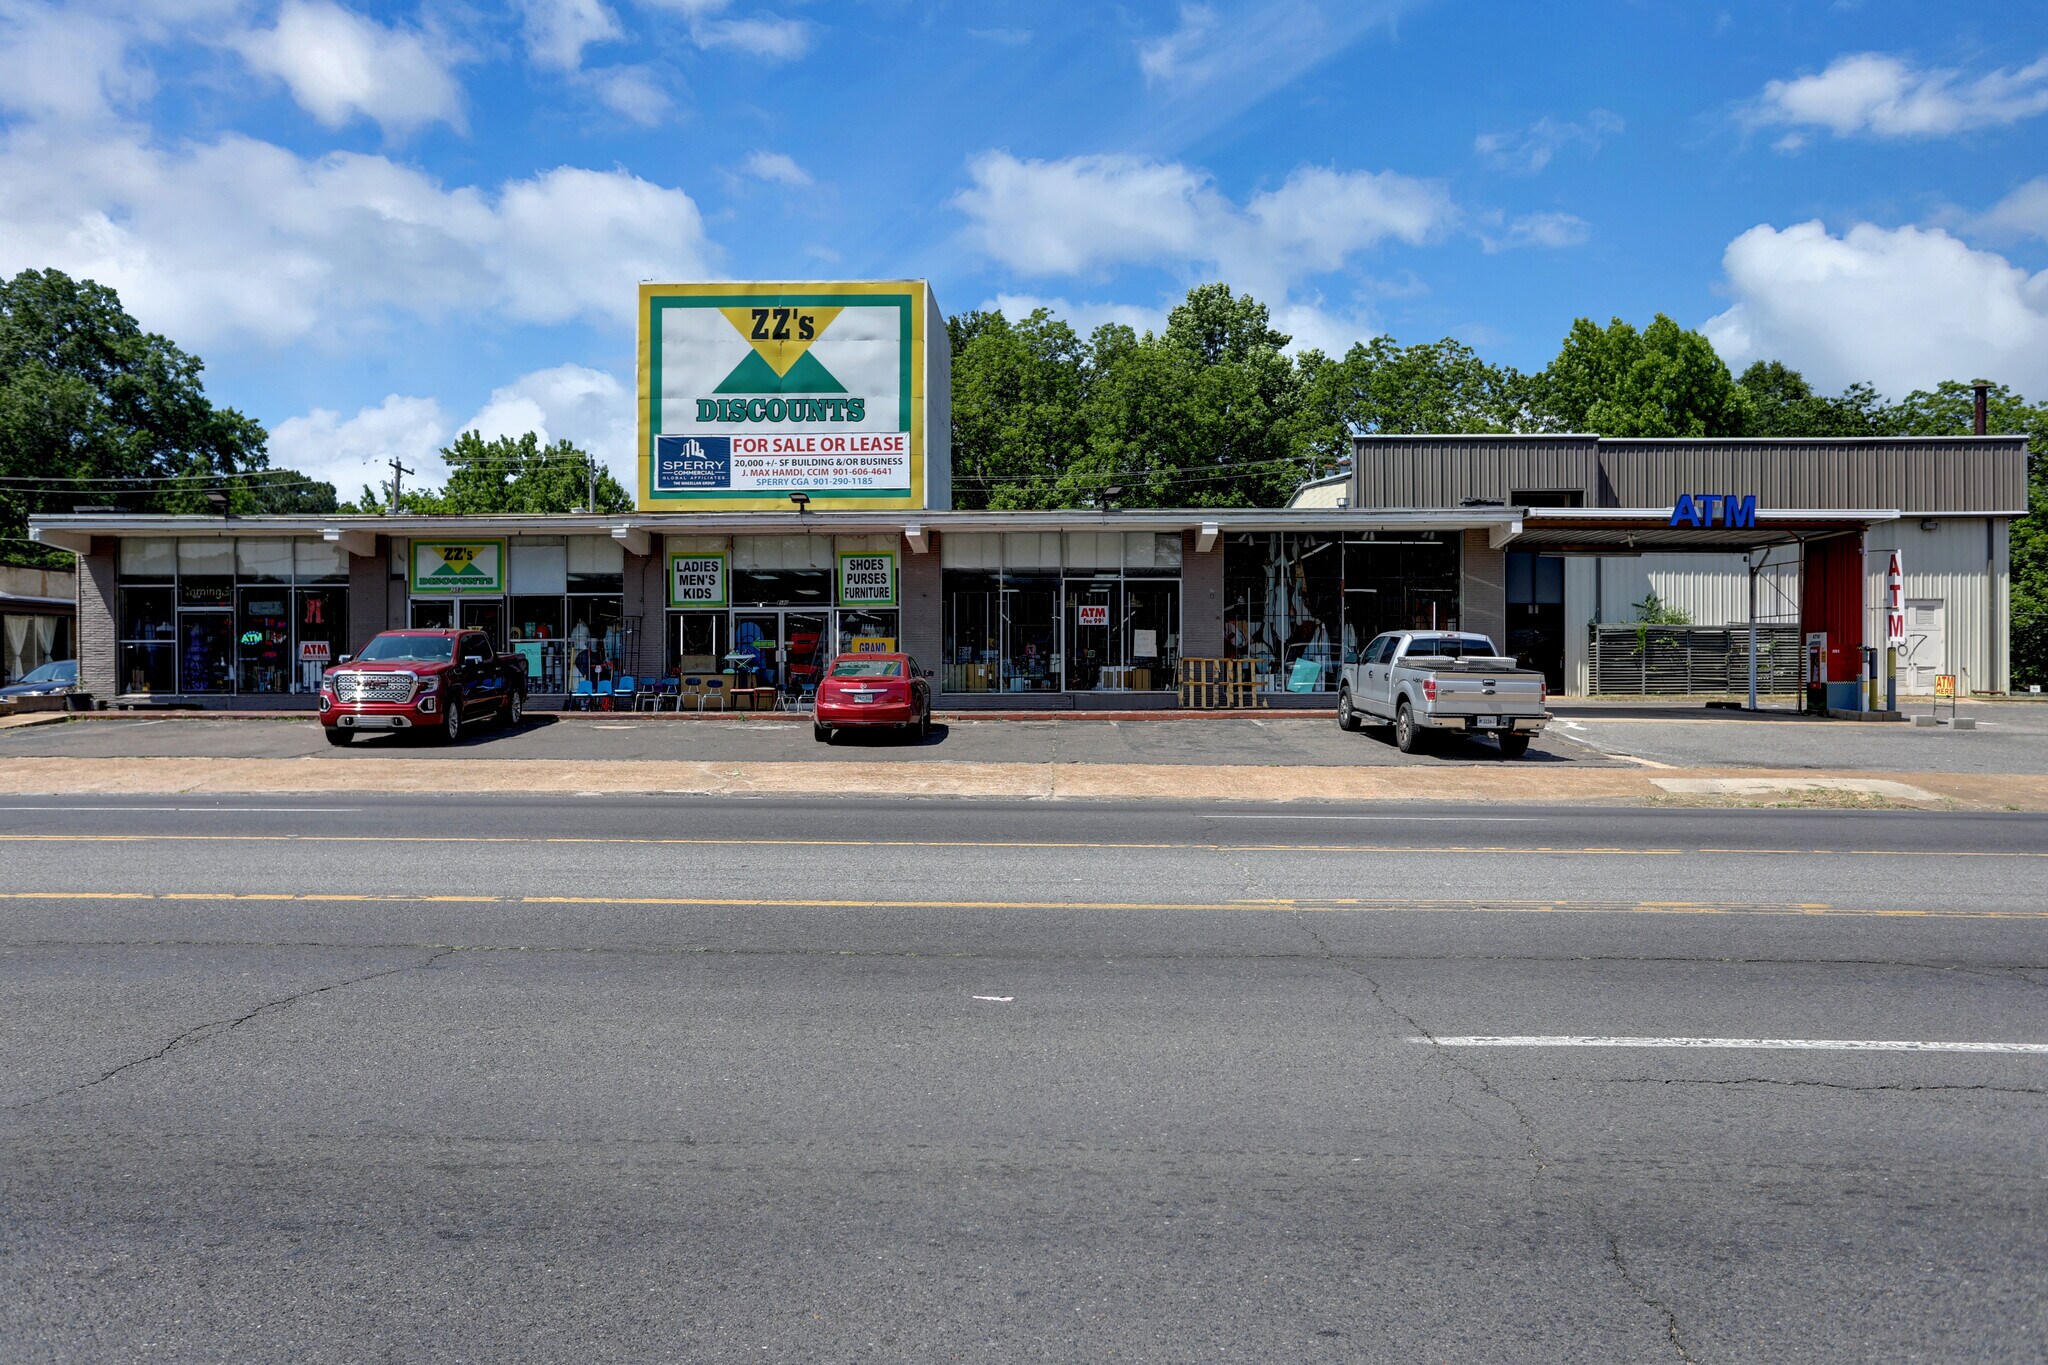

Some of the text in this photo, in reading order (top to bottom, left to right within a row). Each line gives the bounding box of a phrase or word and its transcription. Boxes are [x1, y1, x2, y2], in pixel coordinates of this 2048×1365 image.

[751, 308, 815, 340] ZZ's
[696, 398, 865, 422] DISCOUNTS
[734, 437, 904, 452] FOR SALE OR LEASE
[663, 461, 725, 470] SPERRY
[792, 458, 834, 466] BUILDING
[836, 458, 859, 466] &/OR
[860, 457, 903, 465] BUSINESS
[807, 468, 829, 476] CCIM
[756, 478, 788, 486] SPERRY
[1669, 494, 1756, 528] ATM
[444, 548, 473, 560] ZZ's
[676, 561, 719, 572] LADIES
[849, 559, 883, 570] SHOES
[419, 576, 493, 585] DISCOUNTS
[679, 574, 716, 586] MEN'S
[847, 573, 887, 585] PURSES
[684, 588, 712, 600] KIDS
[844, 587, 889, 598] FURNITURE
[1888, 554, 1903, 638] ATM
[1081, 608, 1105, 617] ATM
[241, 633, 262, 643] ATM
[304, 644, 327, 654] ATM
[859, 642, 887, 652] GRAND
[1936, 676, 1954, 688] ATM
